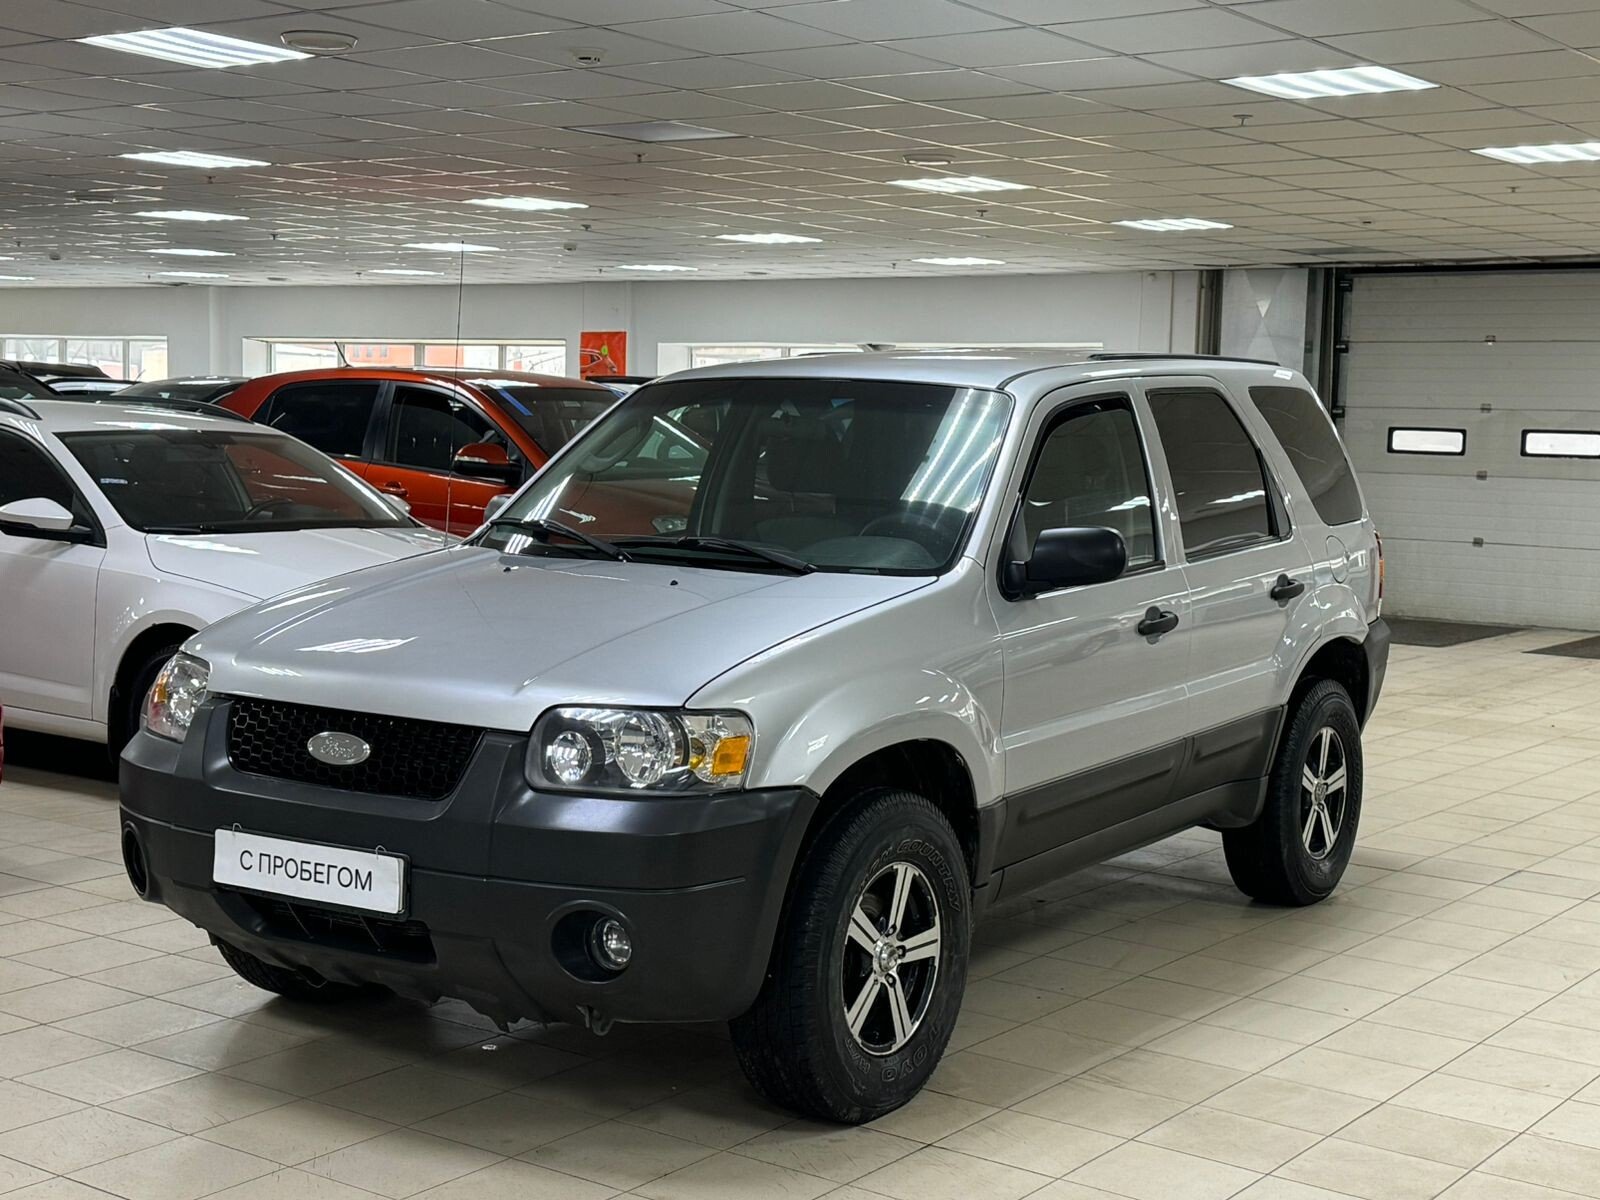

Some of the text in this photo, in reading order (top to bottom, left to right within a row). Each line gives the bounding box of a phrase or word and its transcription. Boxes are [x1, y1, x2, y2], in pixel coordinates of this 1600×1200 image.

[239, 850, 373, 892] С ПРОБЕГОМ
[896, 838, 962, 913] COUNTRY
